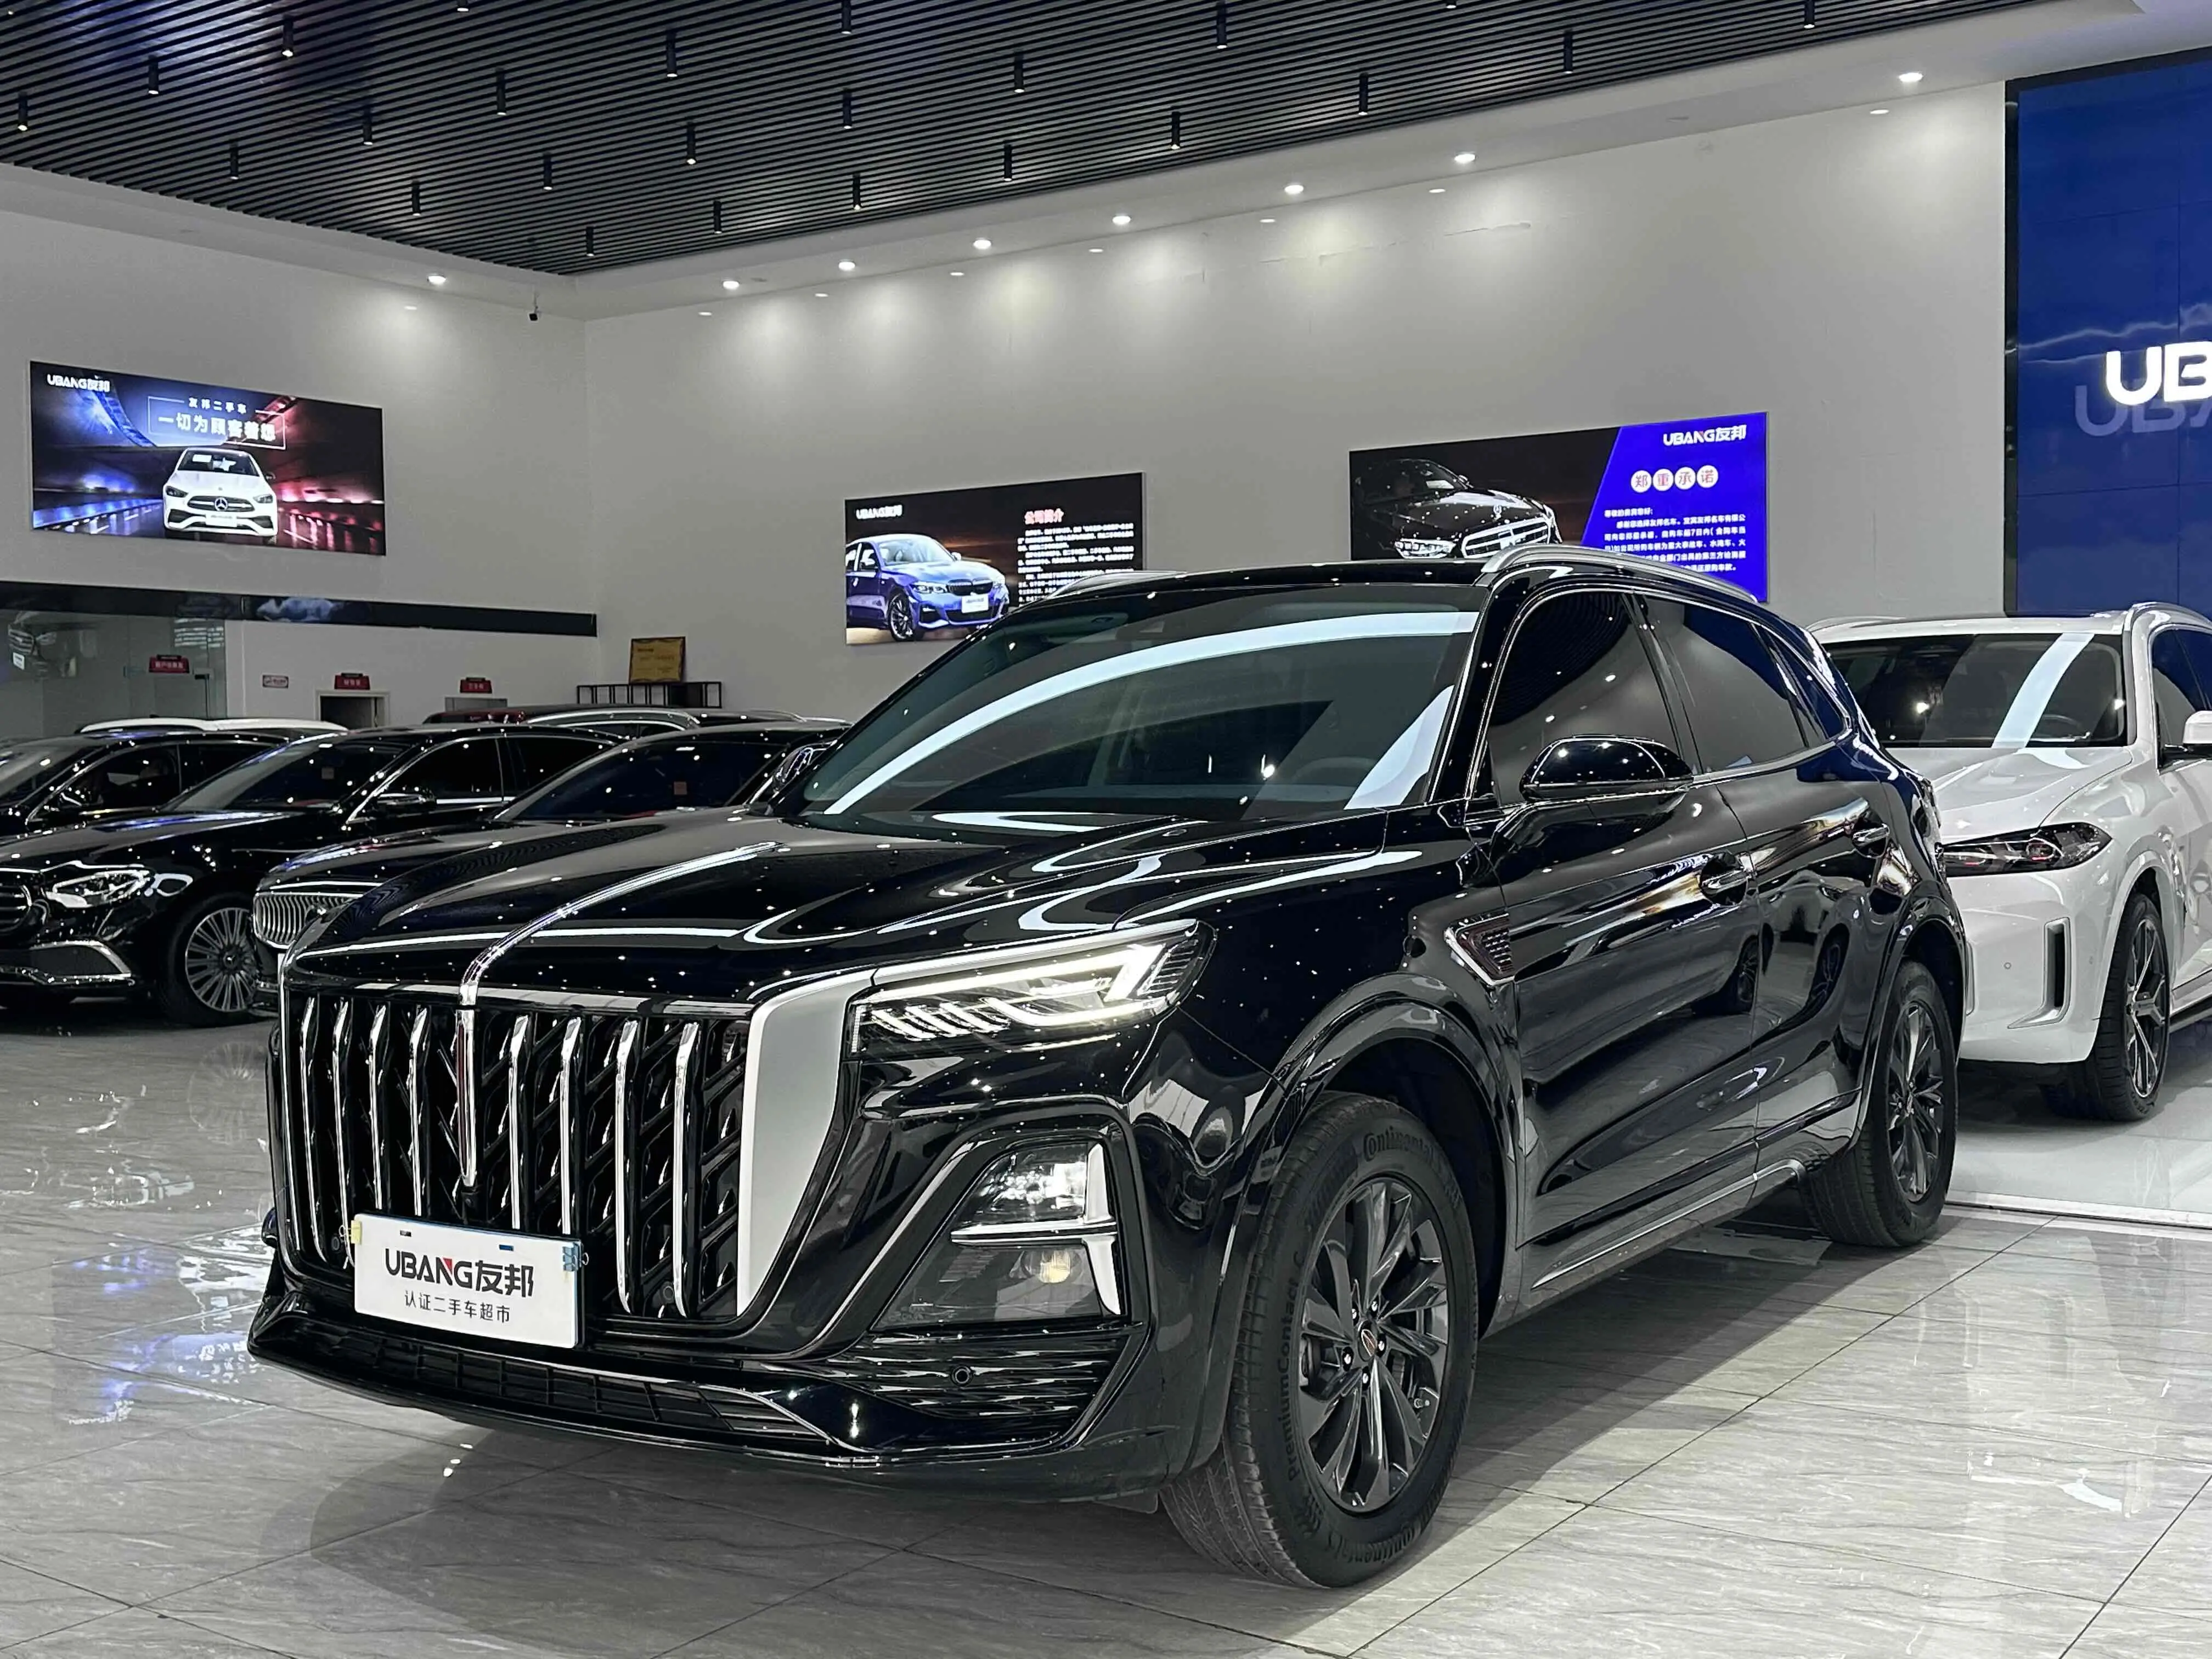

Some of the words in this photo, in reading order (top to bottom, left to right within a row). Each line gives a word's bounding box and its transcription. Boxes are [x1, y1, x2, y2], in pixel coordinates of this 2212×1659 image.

[188, 397, 246, 414] 友邦二手车
[158, 413, 276, 442] 一切为顾客着想
[1663, 425, 1747, 446] UBANG友邦
[385, 1248, 534, 1297] UBANG友邦
[405, 1290, 511, 1323] 认证二手车超市
